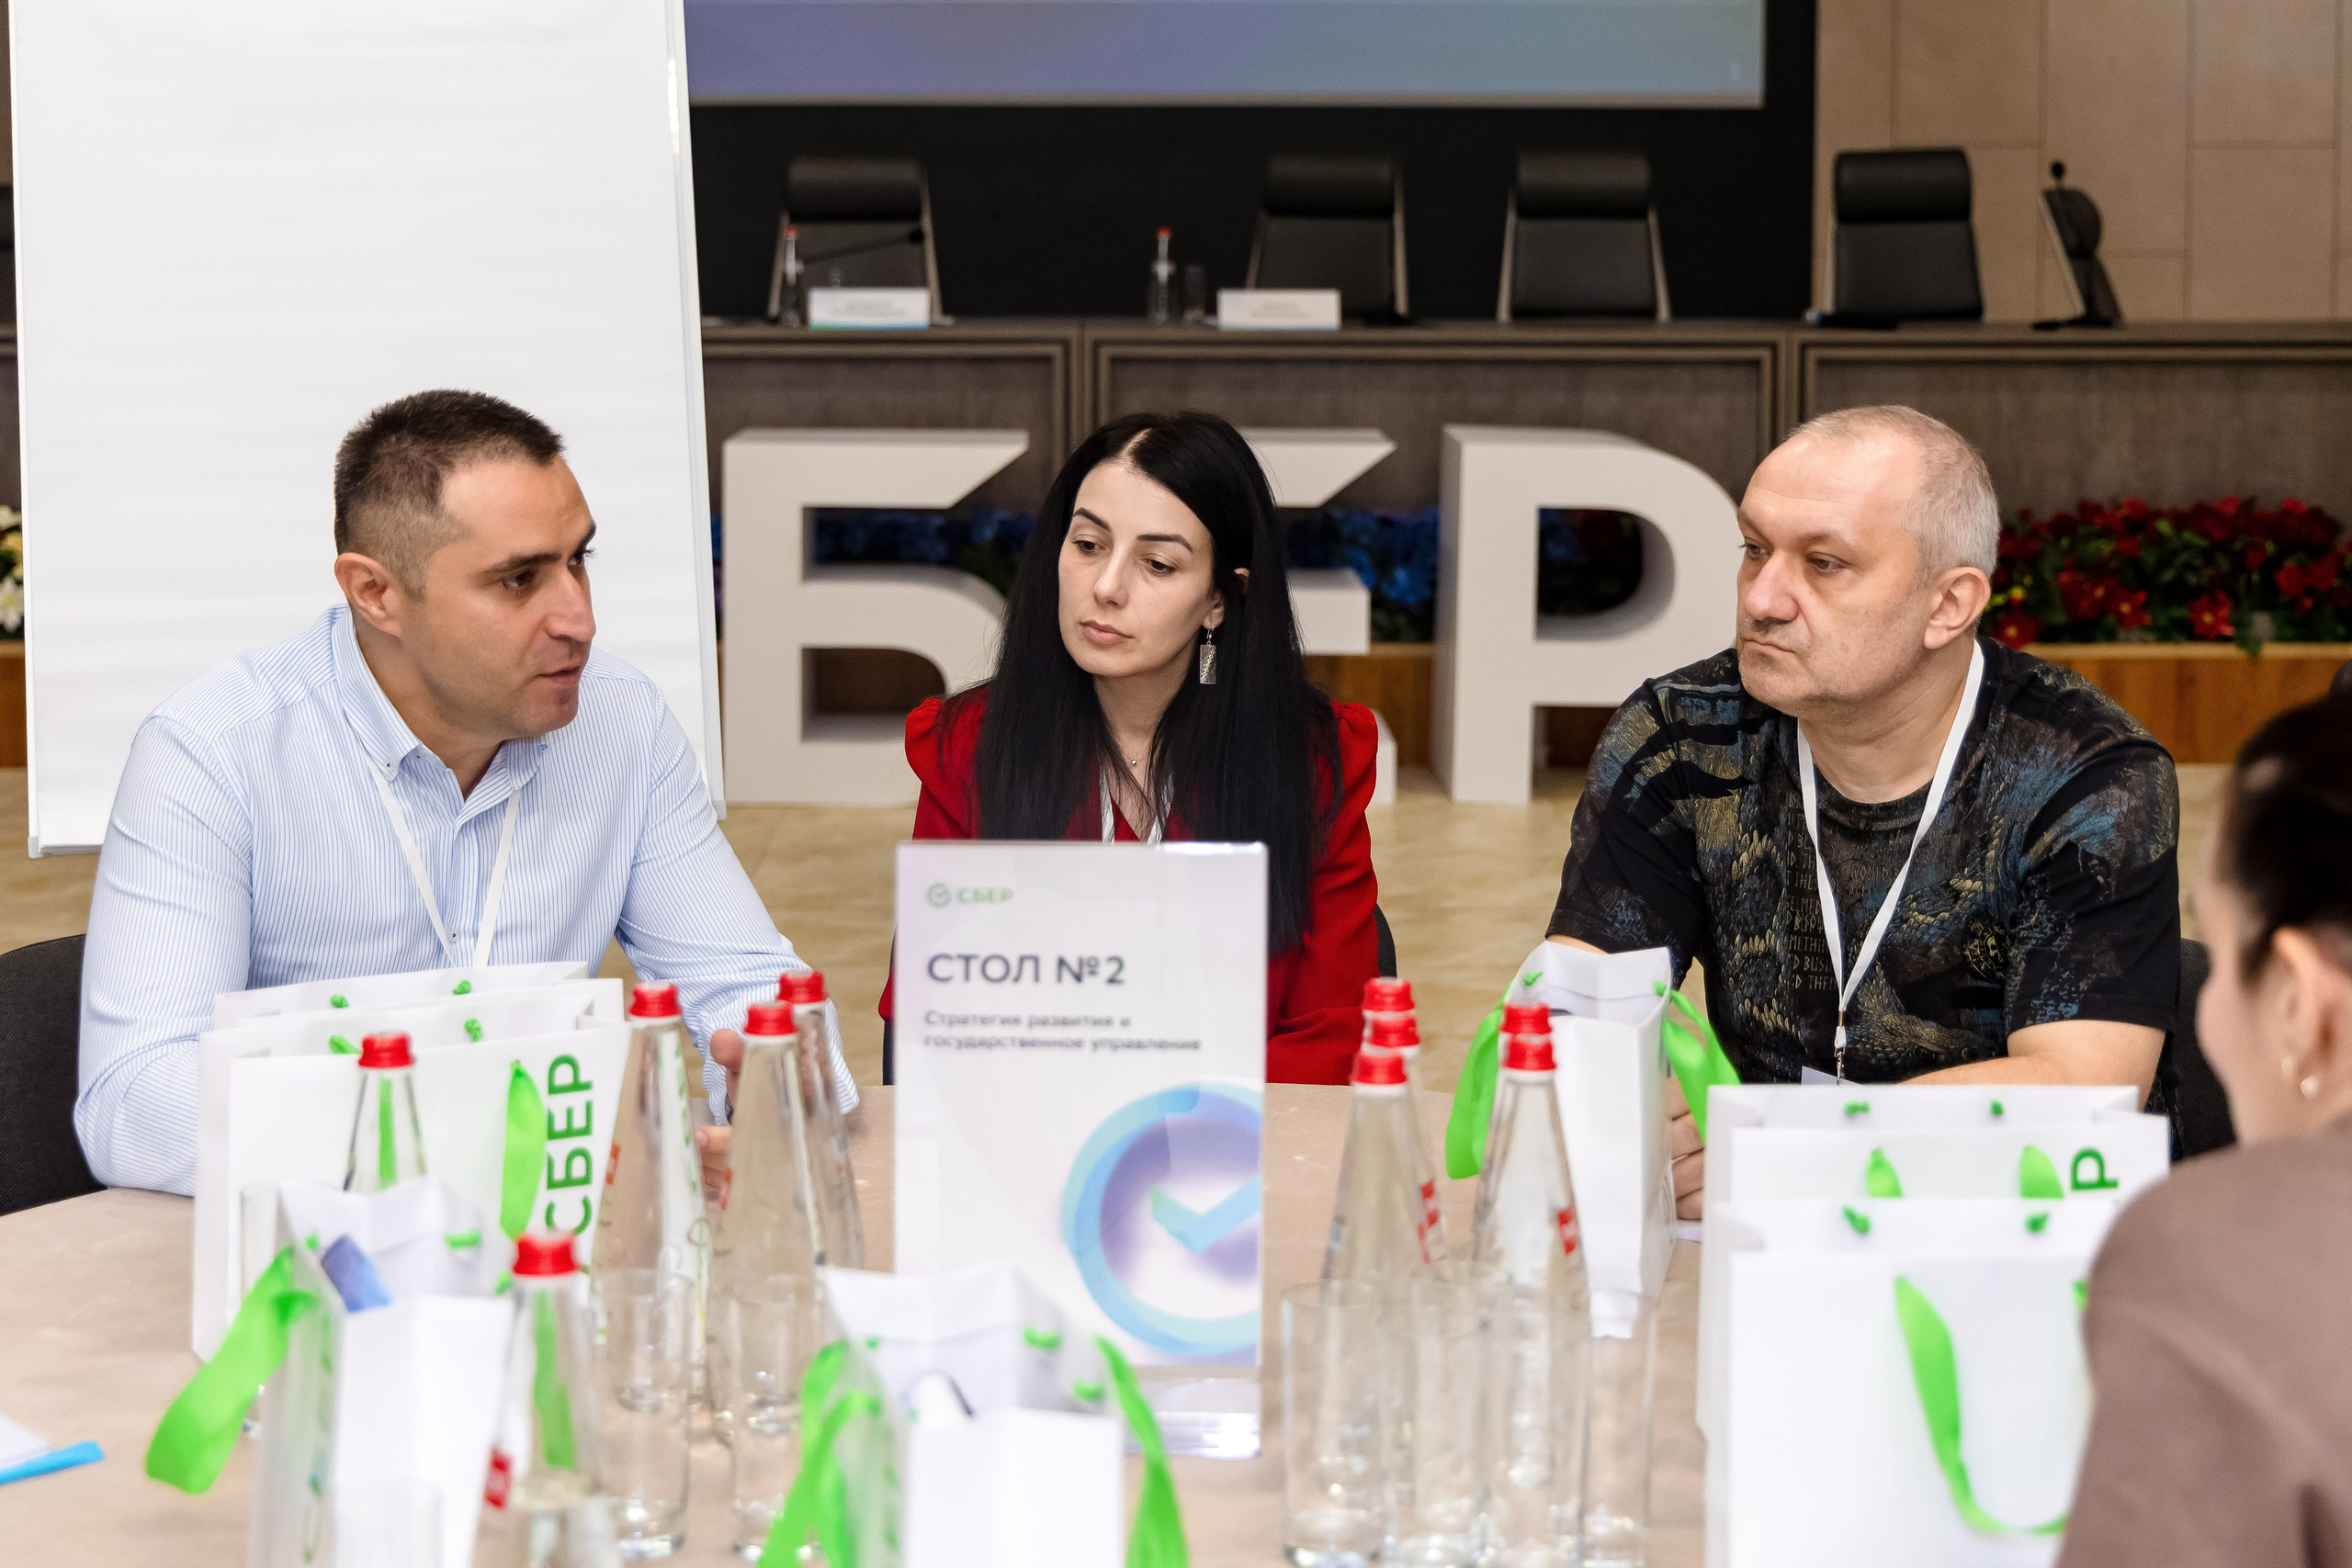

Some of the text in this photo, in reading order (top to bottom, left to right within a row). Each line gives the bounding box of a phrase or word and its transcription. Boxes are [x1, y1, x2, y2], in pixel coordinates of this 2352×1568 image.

[956, 886, 1015, 905] СБЕР
[927, 953, 1125, 985] СТОЛ №2
[924, 1009, 1132, 1030] Стратегия развития и
[923, 1035, 1202, 1054] государственное управление
[545, 1053, 594, 1237] СБЕР
